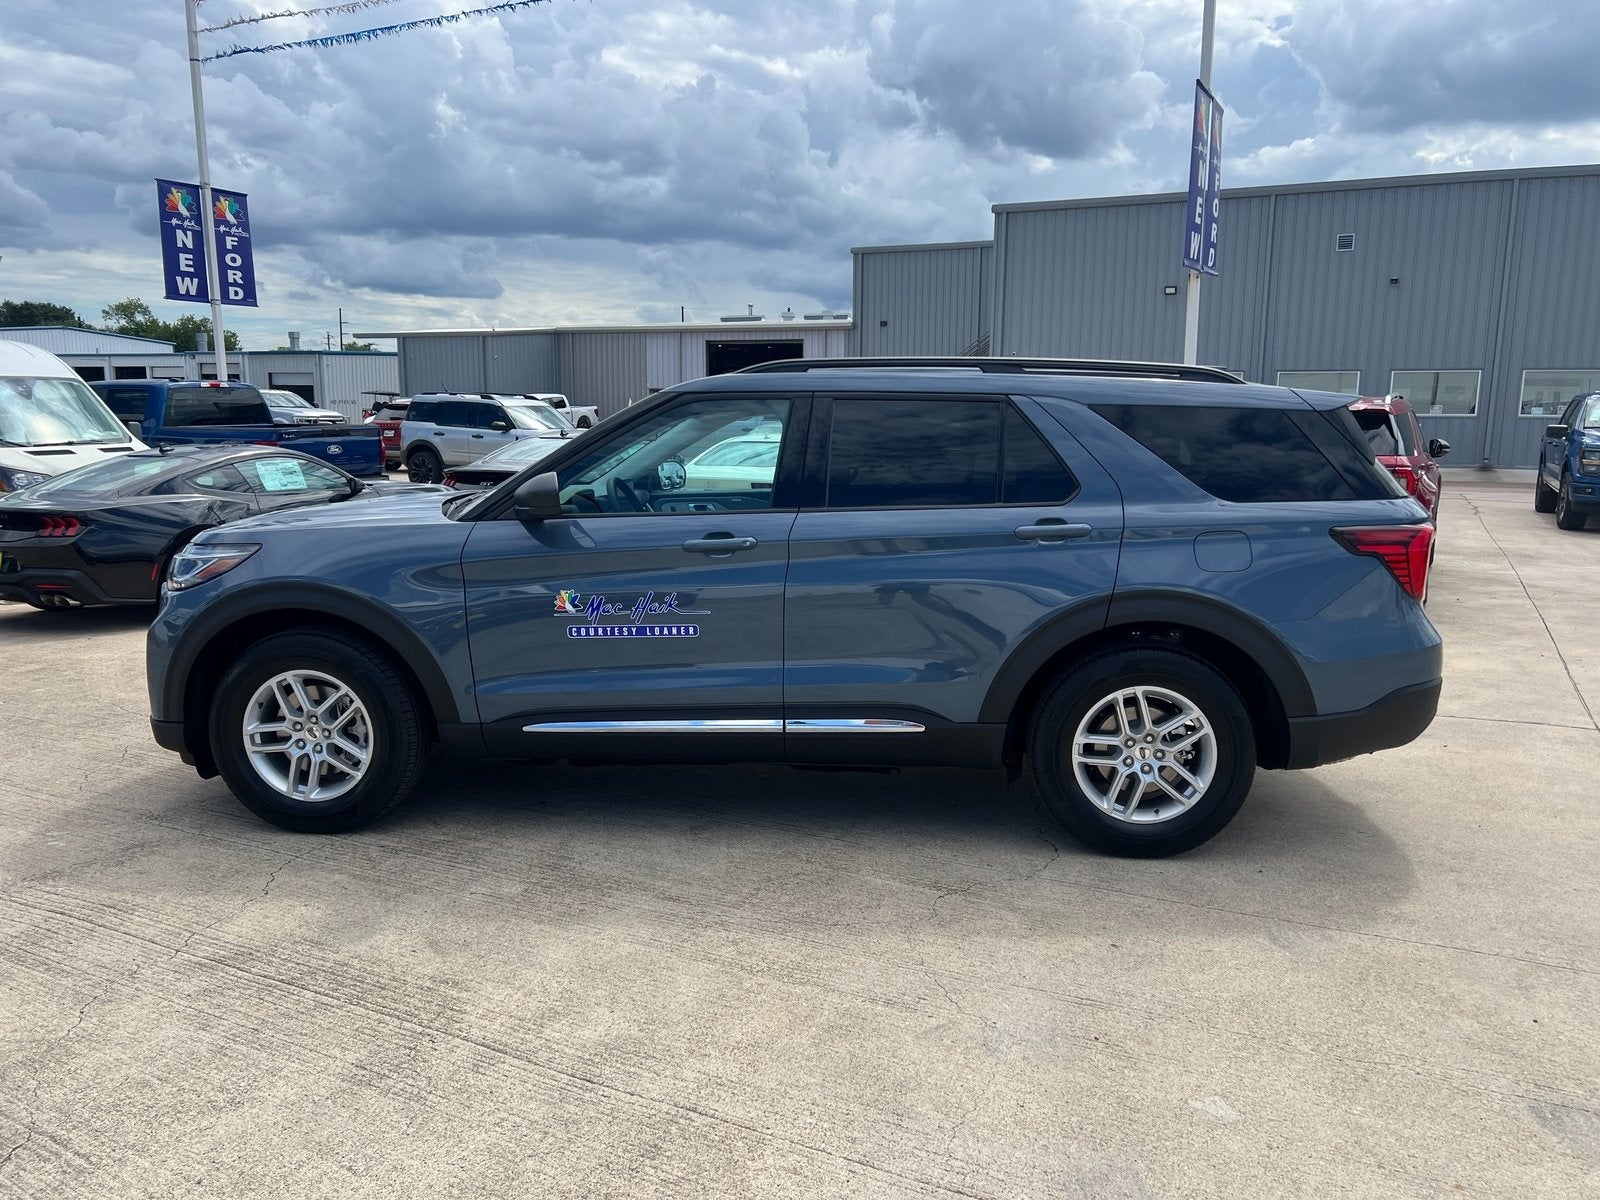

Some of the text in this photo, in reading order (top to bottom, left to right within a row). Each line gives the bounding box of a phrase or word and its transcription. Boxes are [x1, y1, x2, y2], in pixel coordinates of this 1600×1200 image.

[1190, 160, 1206, 260] NEW
[1208, 172, 1220, 268] FORD
[175, 229, 199, 296] NEW
[225, 236, 244, 300] FORD
[571, 626, 695, 636] COURTESY LOANER
[578, 591, 694, 626] Mac Haik
